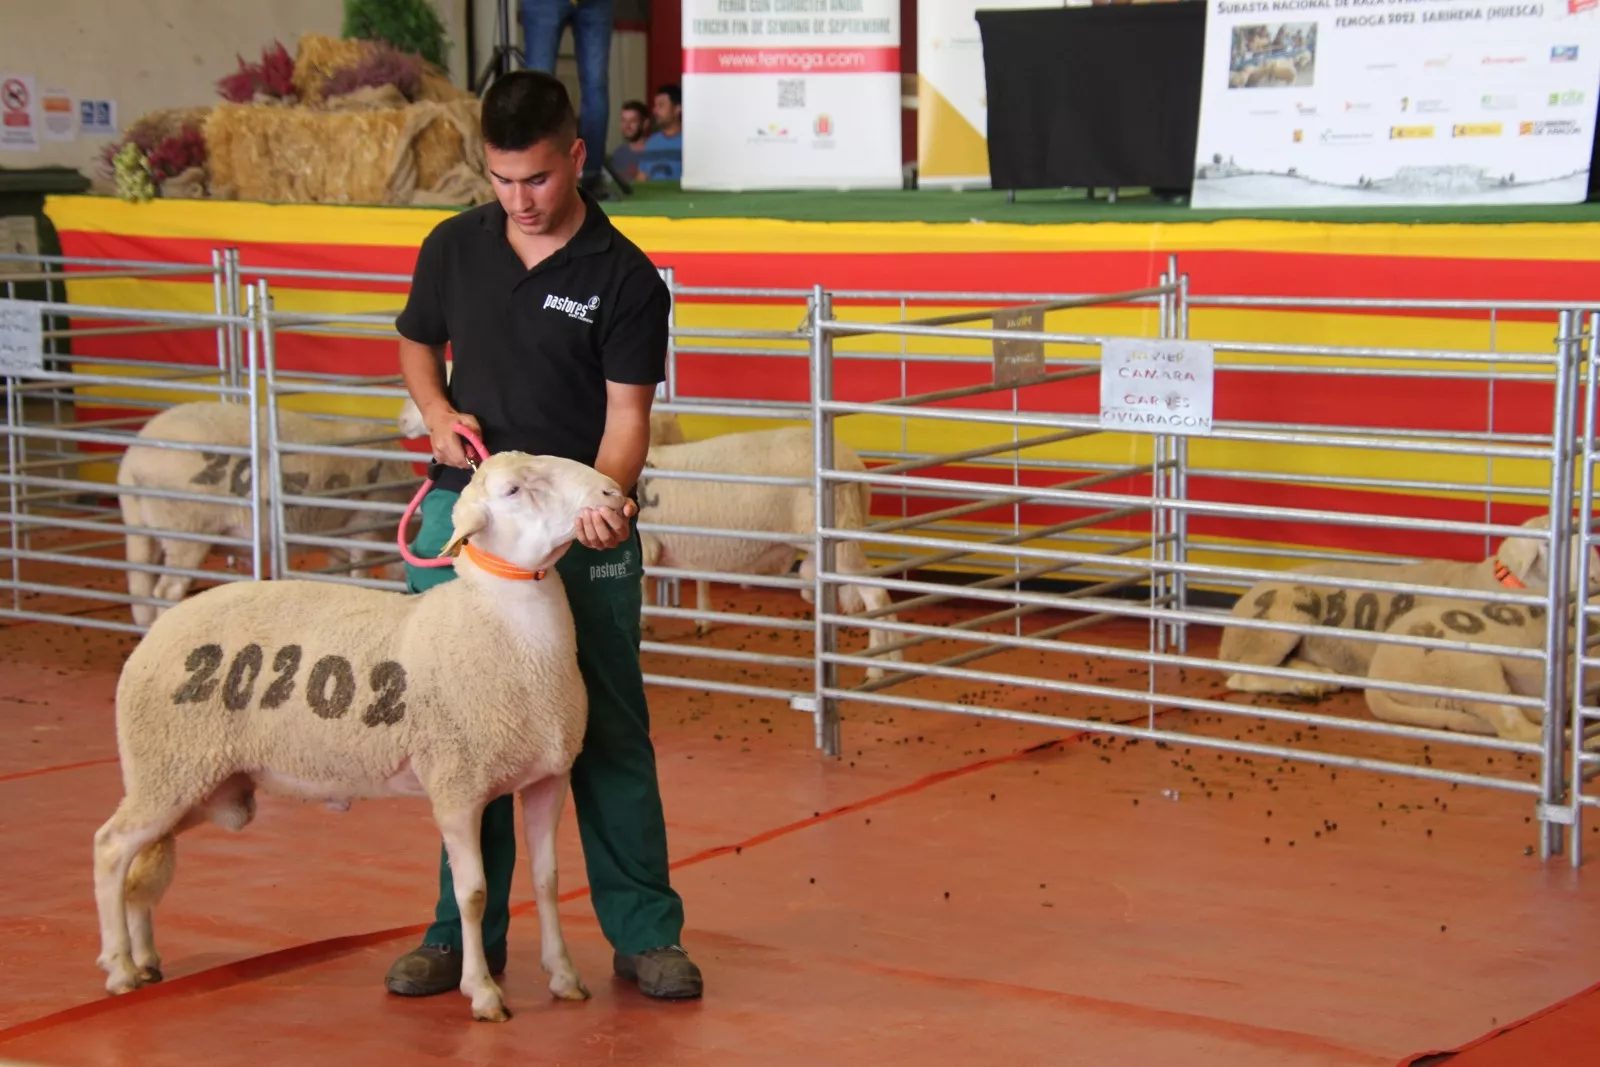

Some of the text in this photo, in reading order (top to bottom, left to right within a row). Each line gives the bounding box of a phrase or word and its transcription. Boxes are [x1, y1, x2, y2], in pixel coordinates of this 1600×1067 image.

[692, 18, 891, 36] TERCER FIN DE SEMANA DE SEPTIEMBRE
[1335, 15, 1385, 28] FEMOGA
[1486, 4, 1545, 21] (HUESCA)
[718, 51, 866, 72] www.femoga.com
[543, 294, 589, 318] pastores
[589, 562, 627, 581] pastores
[170, 643, 408, 728] 20202
